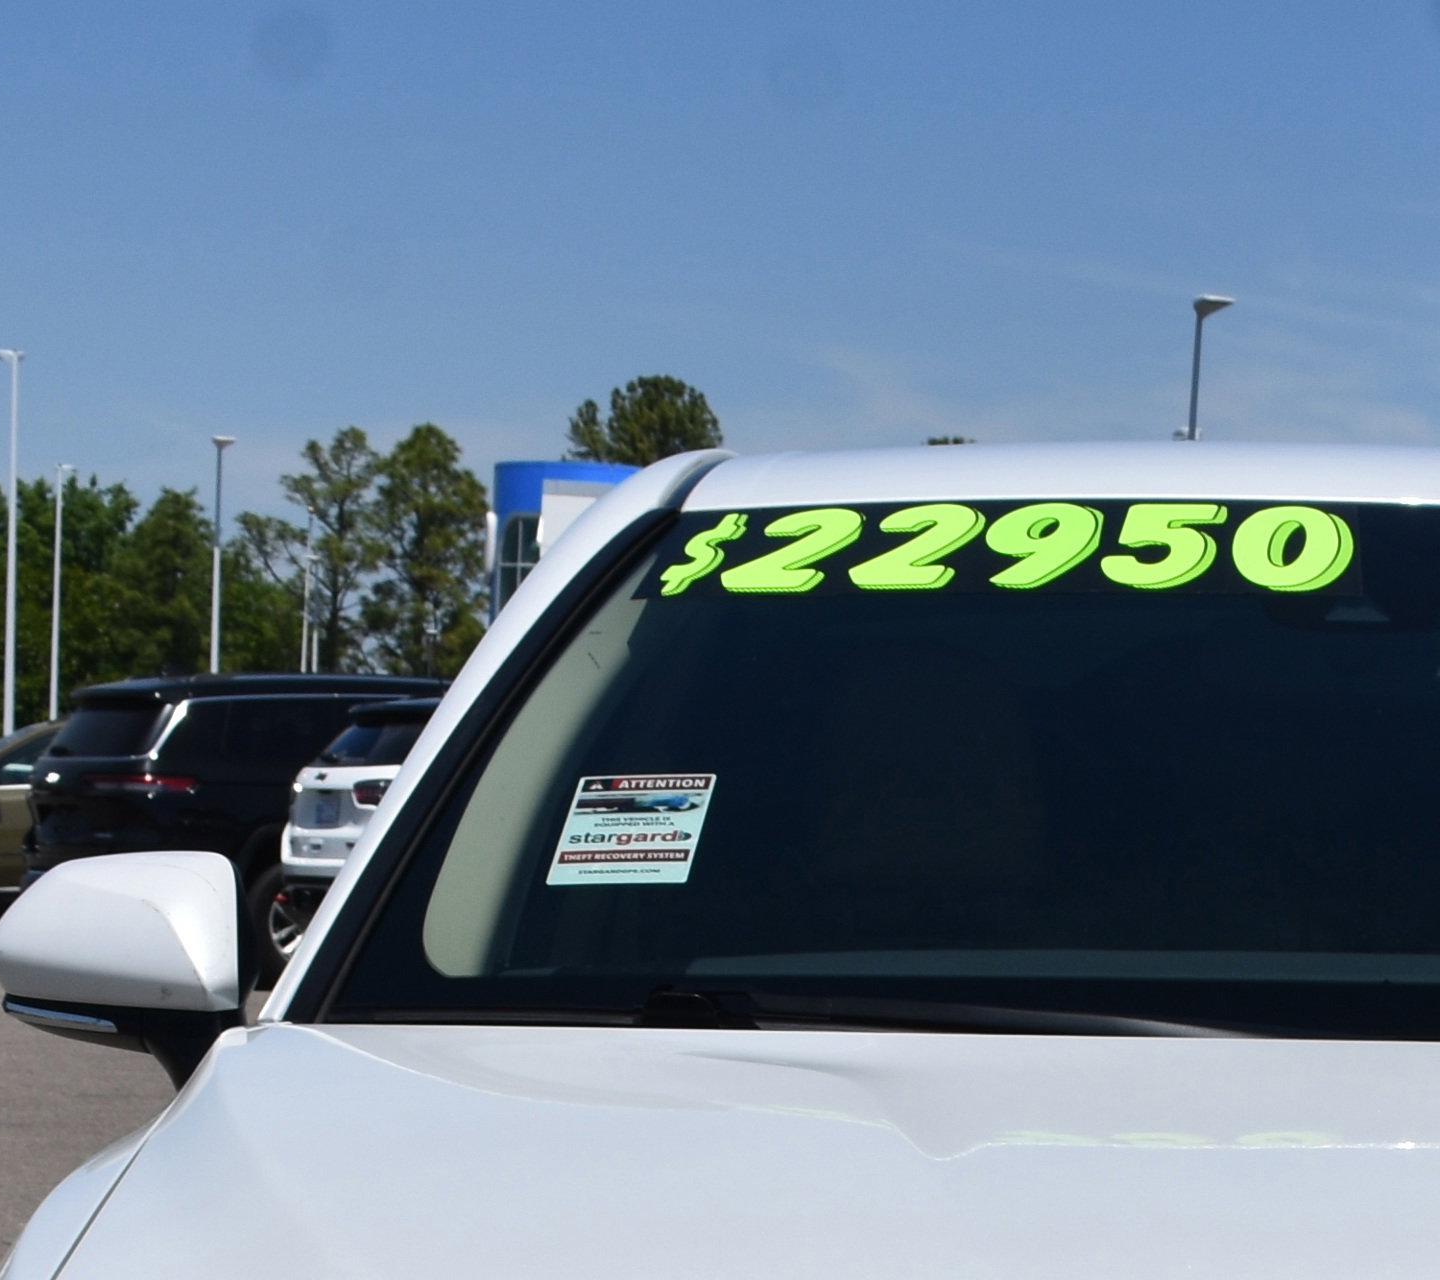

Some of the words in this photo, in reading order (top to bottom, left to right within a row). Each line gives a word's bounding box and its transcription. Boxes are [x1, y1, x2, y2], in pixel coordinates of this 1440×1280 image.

[661, 503, 1354, 596] $22950
[618, 779, 706, 789] ATTENTION
[569, 830, 678, 846] stargard
